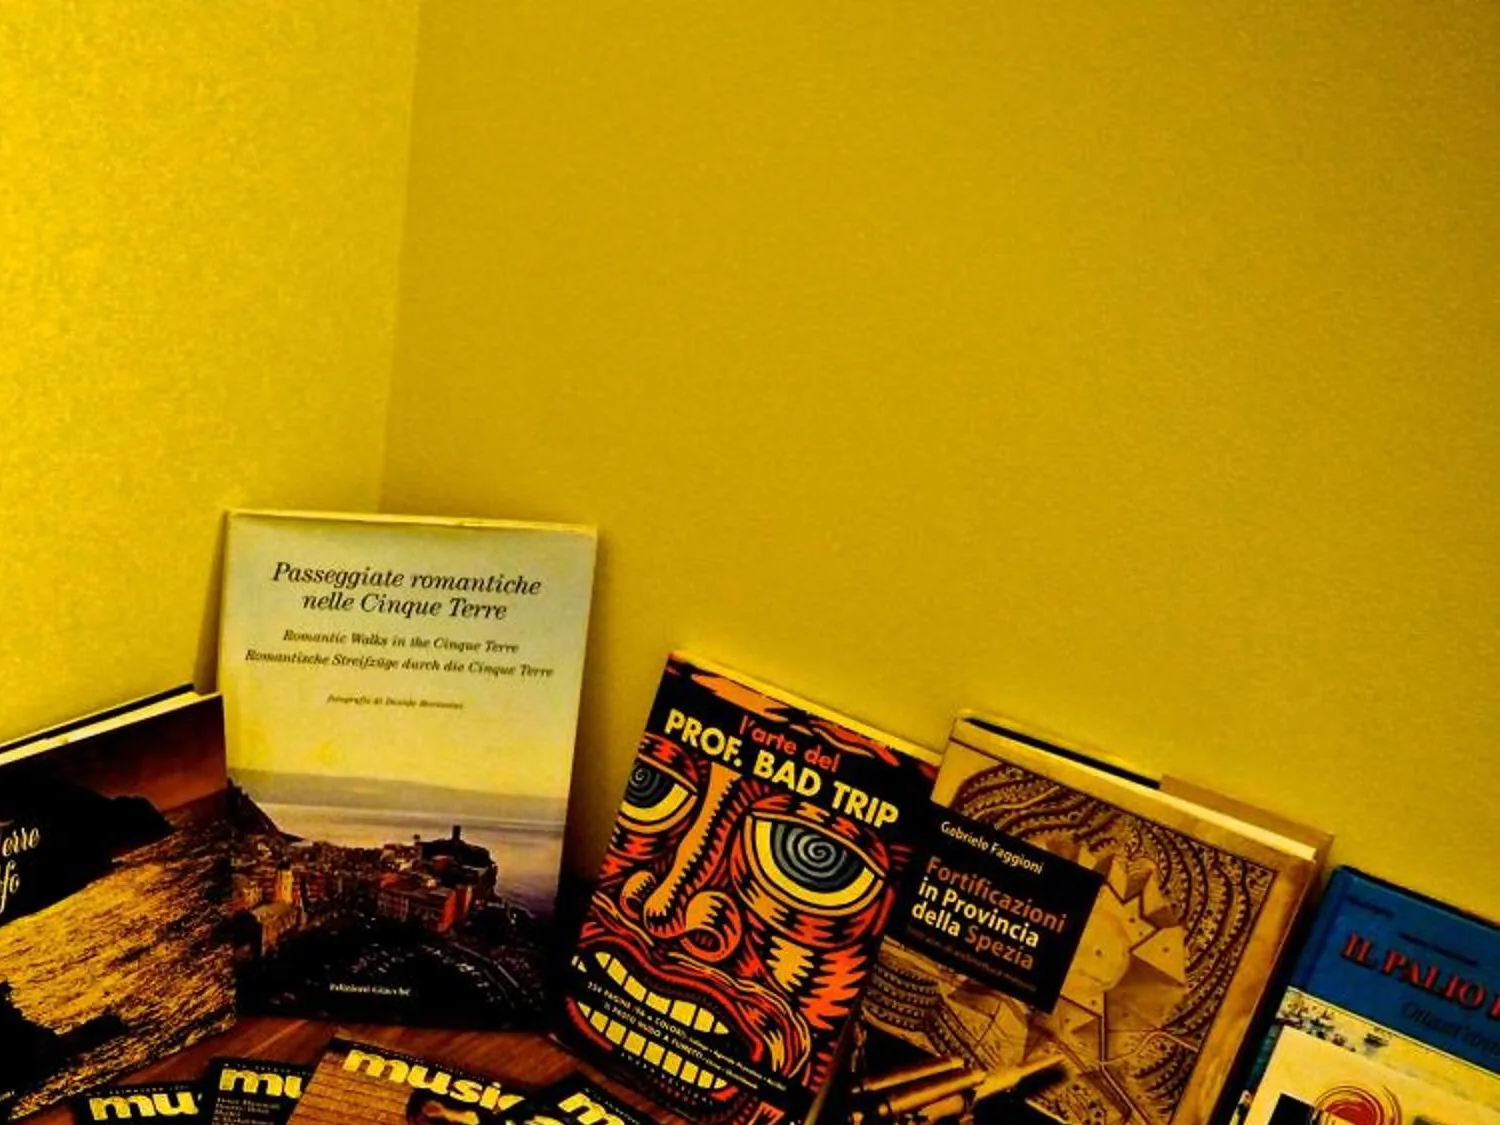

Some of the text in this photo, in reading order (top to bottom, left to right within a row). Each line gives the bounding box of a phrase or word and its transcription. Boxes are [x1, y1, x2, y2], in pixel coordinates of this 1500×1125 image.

[272, 562, 541, 595] Passeggiate romantiche
[302, 593, 507, 620] nelle Cinque Terre
[283, 630, 518, 654] Romantic Walks in the Cinque Terre
[245, 650, 328, 665] Romantische
[403, 658, 439, 672] durch
[444, 660, 464, 673] die
[468, 662, 515, 677] Cinque
[520, 666, 553, 677] Terre
[665, 708, 899, 828] PROF. BAD TRIP
[804, 746, 841, 773] del
[927, 856, 1066, 933] Fortificazioni
[912, 902, 960, 936] della
[918, 877, 1039, 948] in Provincia
[1341, 932, 1375, 963] IL
[1382, 949, 1486, 1010] PALIO
